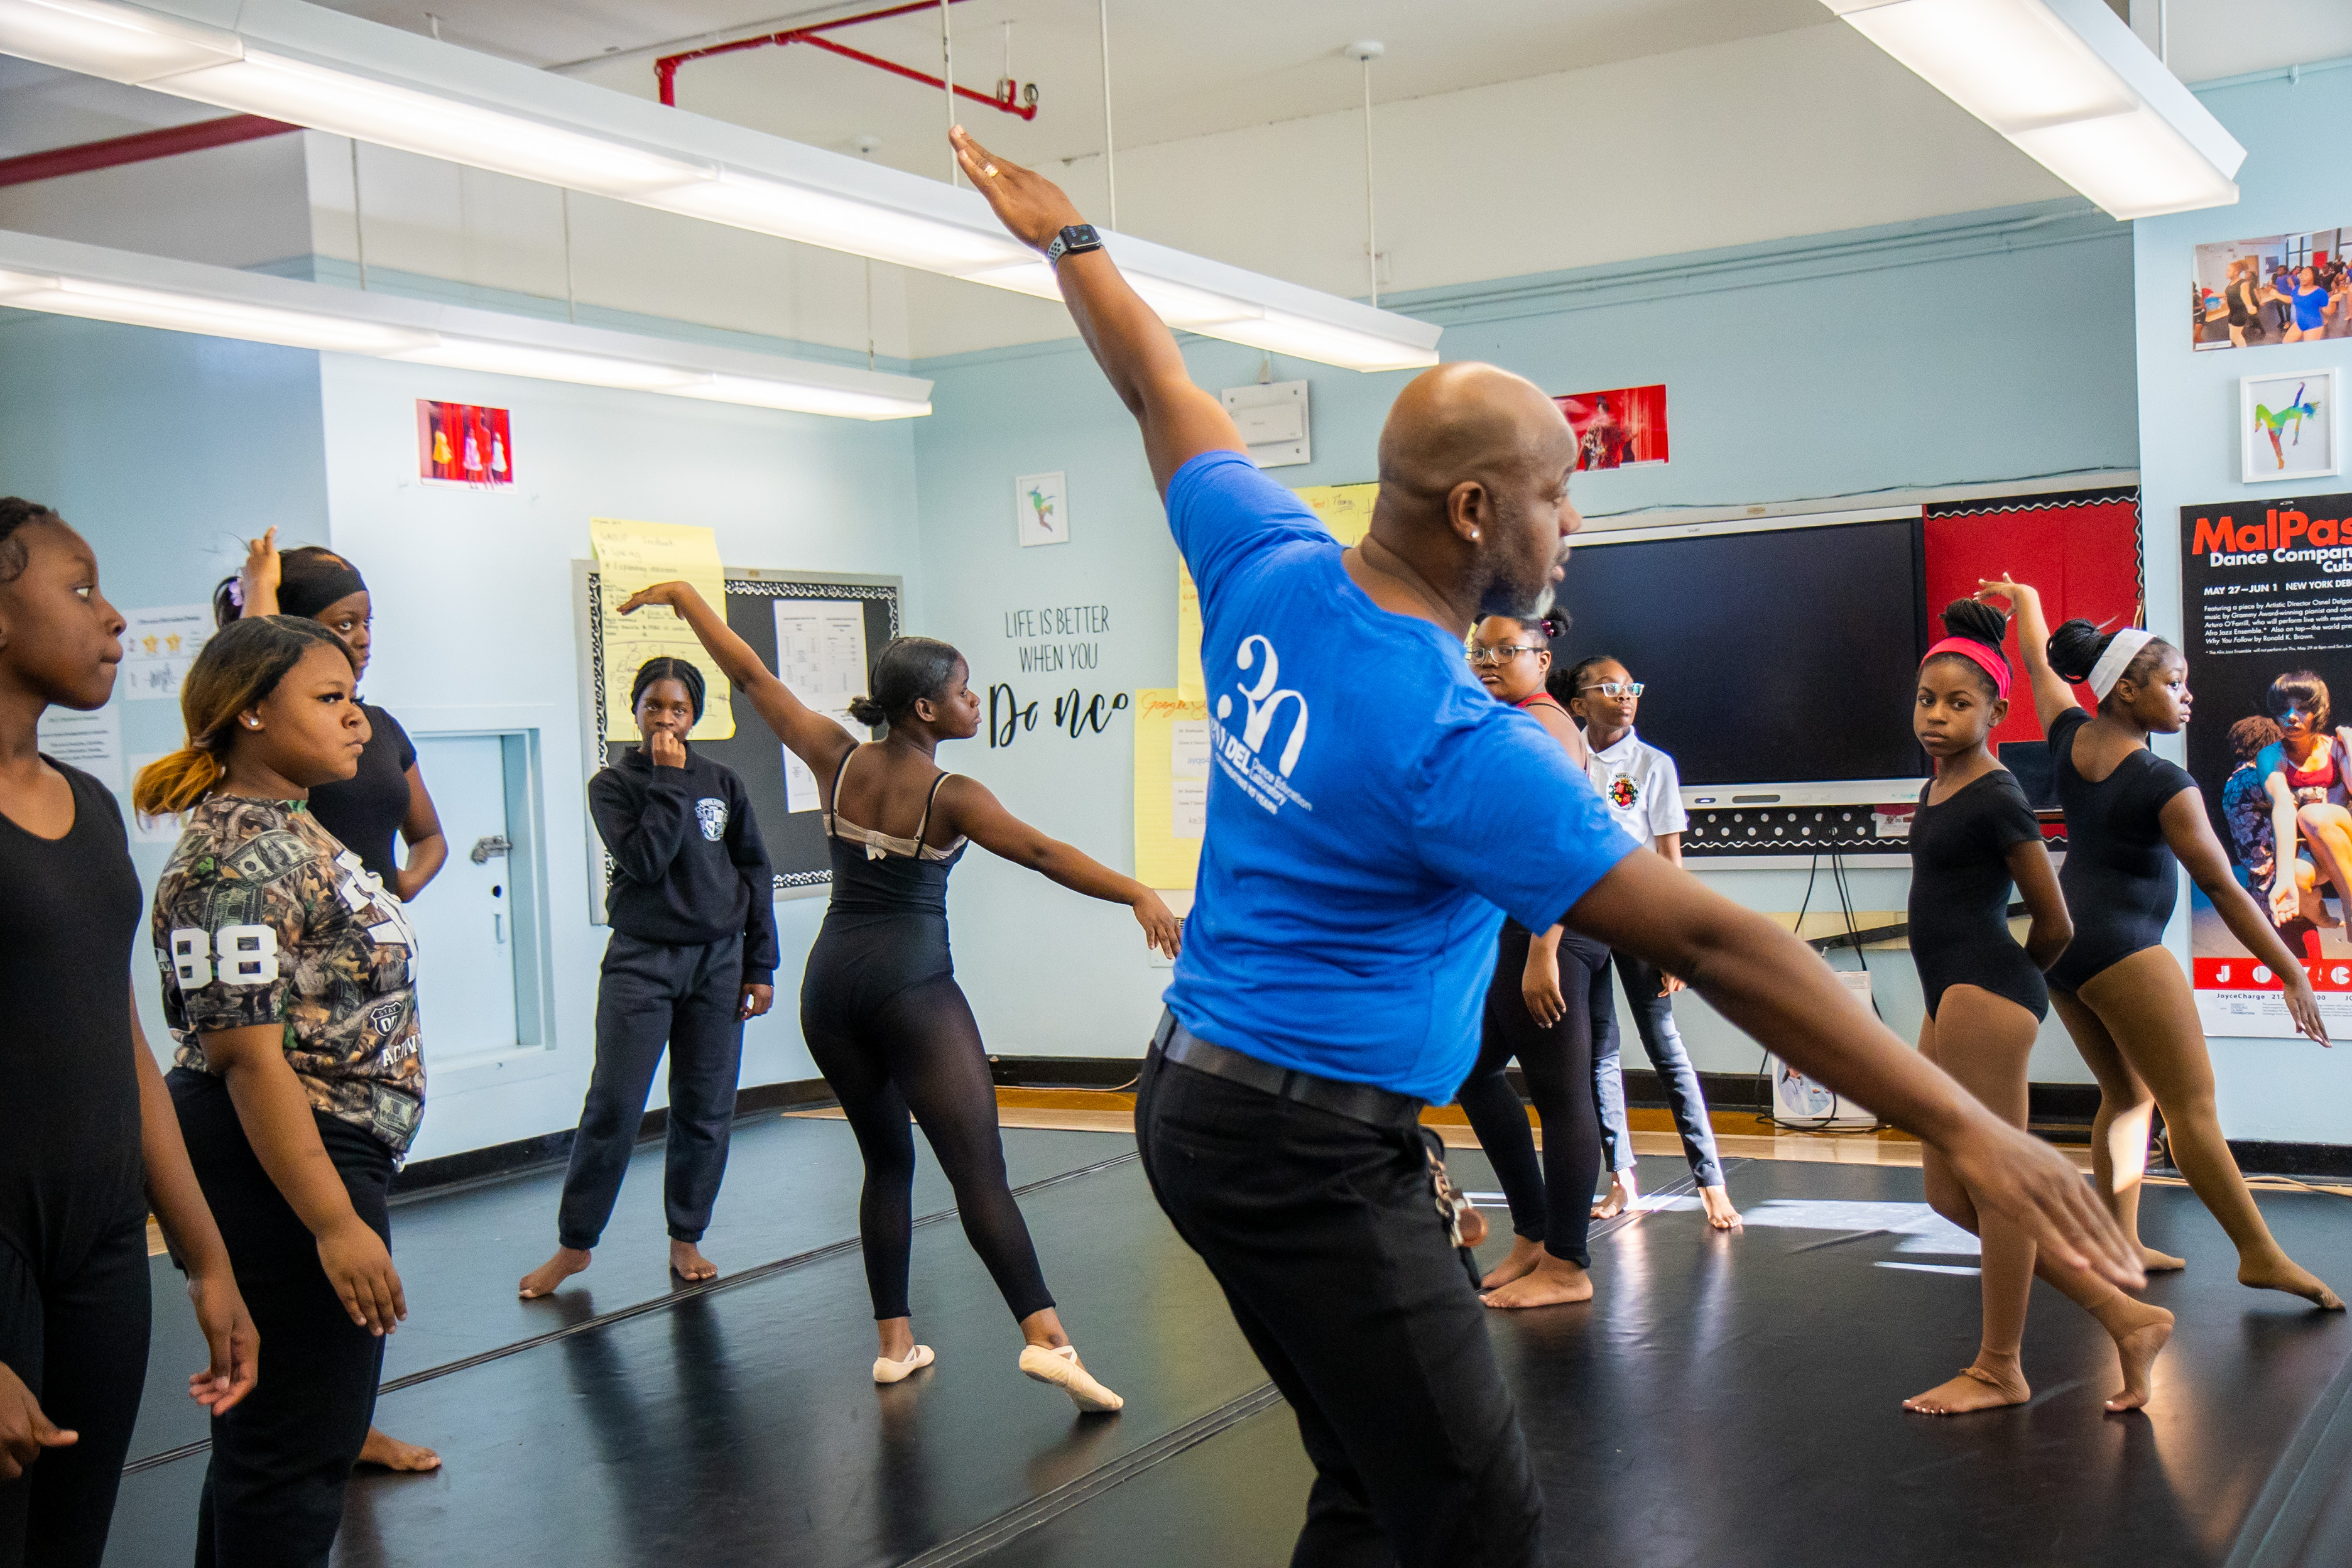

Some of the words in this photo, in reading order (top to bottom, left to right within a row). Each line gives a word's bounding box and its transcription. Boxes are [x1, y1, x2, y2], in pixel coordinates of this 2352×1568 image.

[2210, 552, 2268, 567] Dance
[2322, 558, 2352, 573] Cub
[2204, 586, 2226, 596] MAY
[2272, 583, 2278, 592] 1
[2285, 581, 2307, 591] NEW
[2308, 580, 2334, 589] YORK
[2335, 579, 2352, 588] DEB
[1005, 610, 1037, 638] LIFE
[1040, 608, 1053, 636] IS
[1057, 605, 1110, 635] BETTER
[2222, 612, 2231, 620] by
[2278, 616, 2302, 625] perform
[1019, 645, 1063, 673] WHEN
[1068, 643, 1098, 670] YOU
[1224, 735, 1251, 776] DEL
[378, 1006, 397, 1016] STAY
